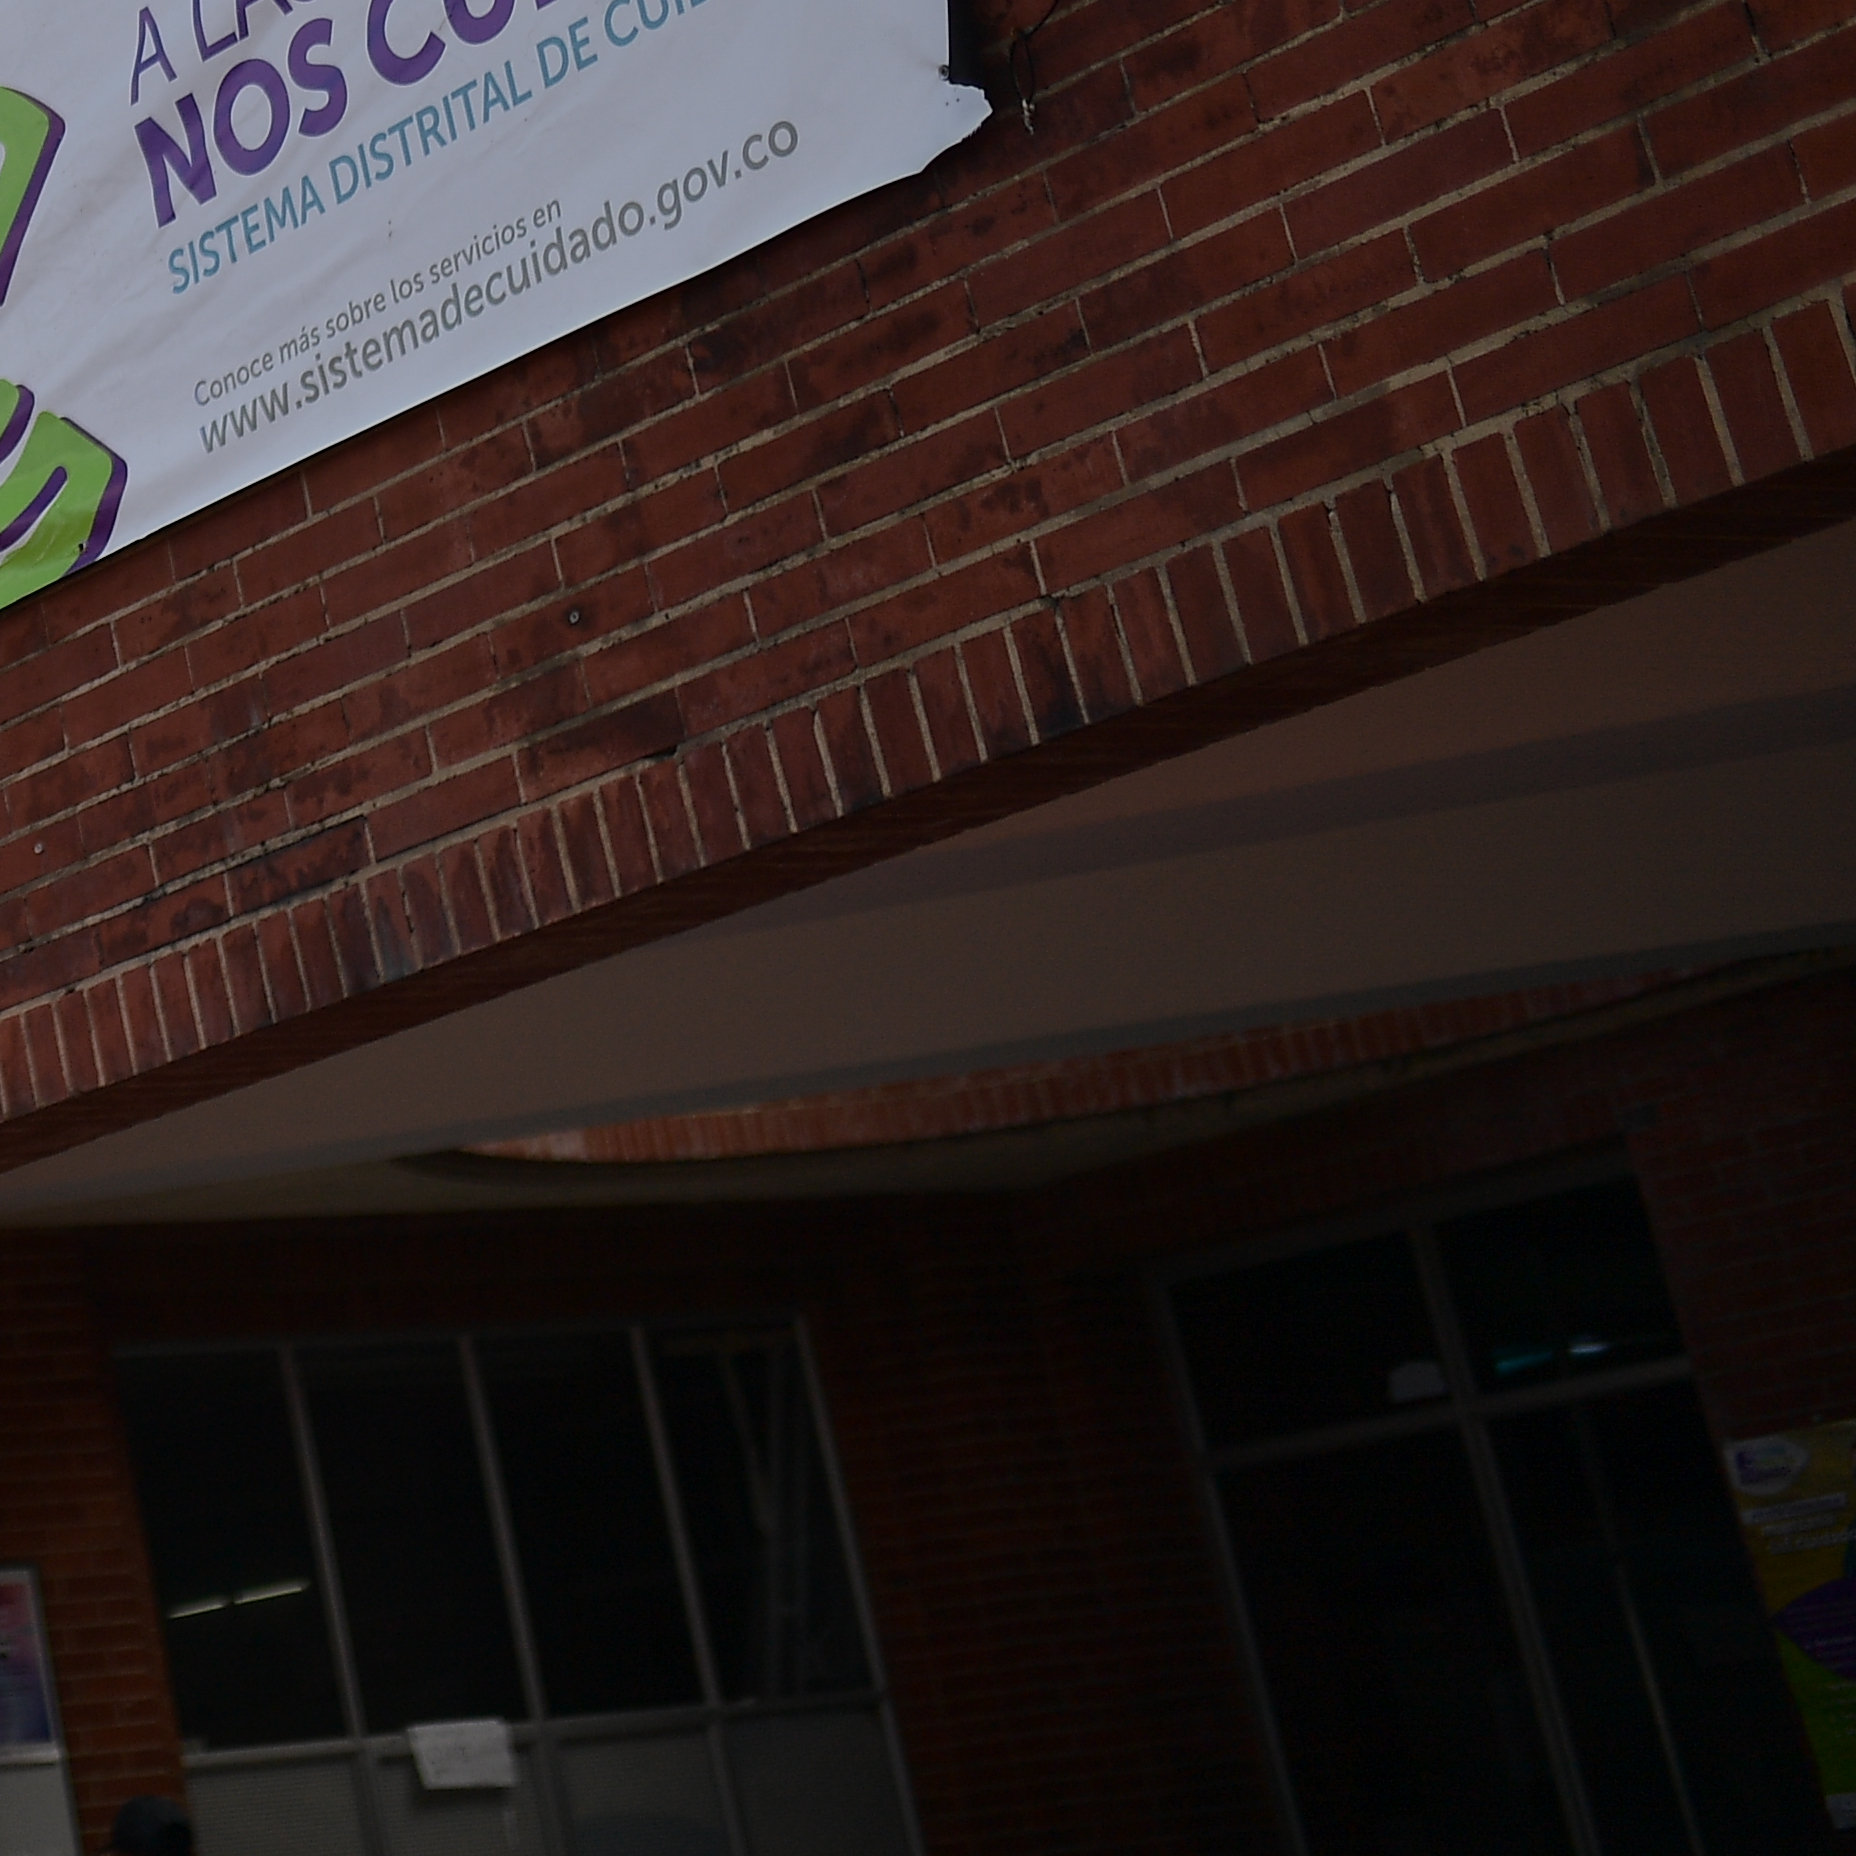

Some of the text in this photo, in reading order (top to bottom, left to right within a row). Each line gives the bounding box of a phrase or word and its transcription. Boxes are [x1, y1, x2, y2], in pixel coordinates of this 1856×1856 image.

[129, 6, 177, 104] A
[133, 18, 348, 228] NOS
[167, 188, 326, 295] SISTEMA
[332, 69, 532, 207] DISTRITAL
[539, 23, 599, 89] DE
[193, 198, 562, 406] Conoce más sobre los servicios en
[199, 120, 800, 454] www.sistemadecuidado.gov.co
